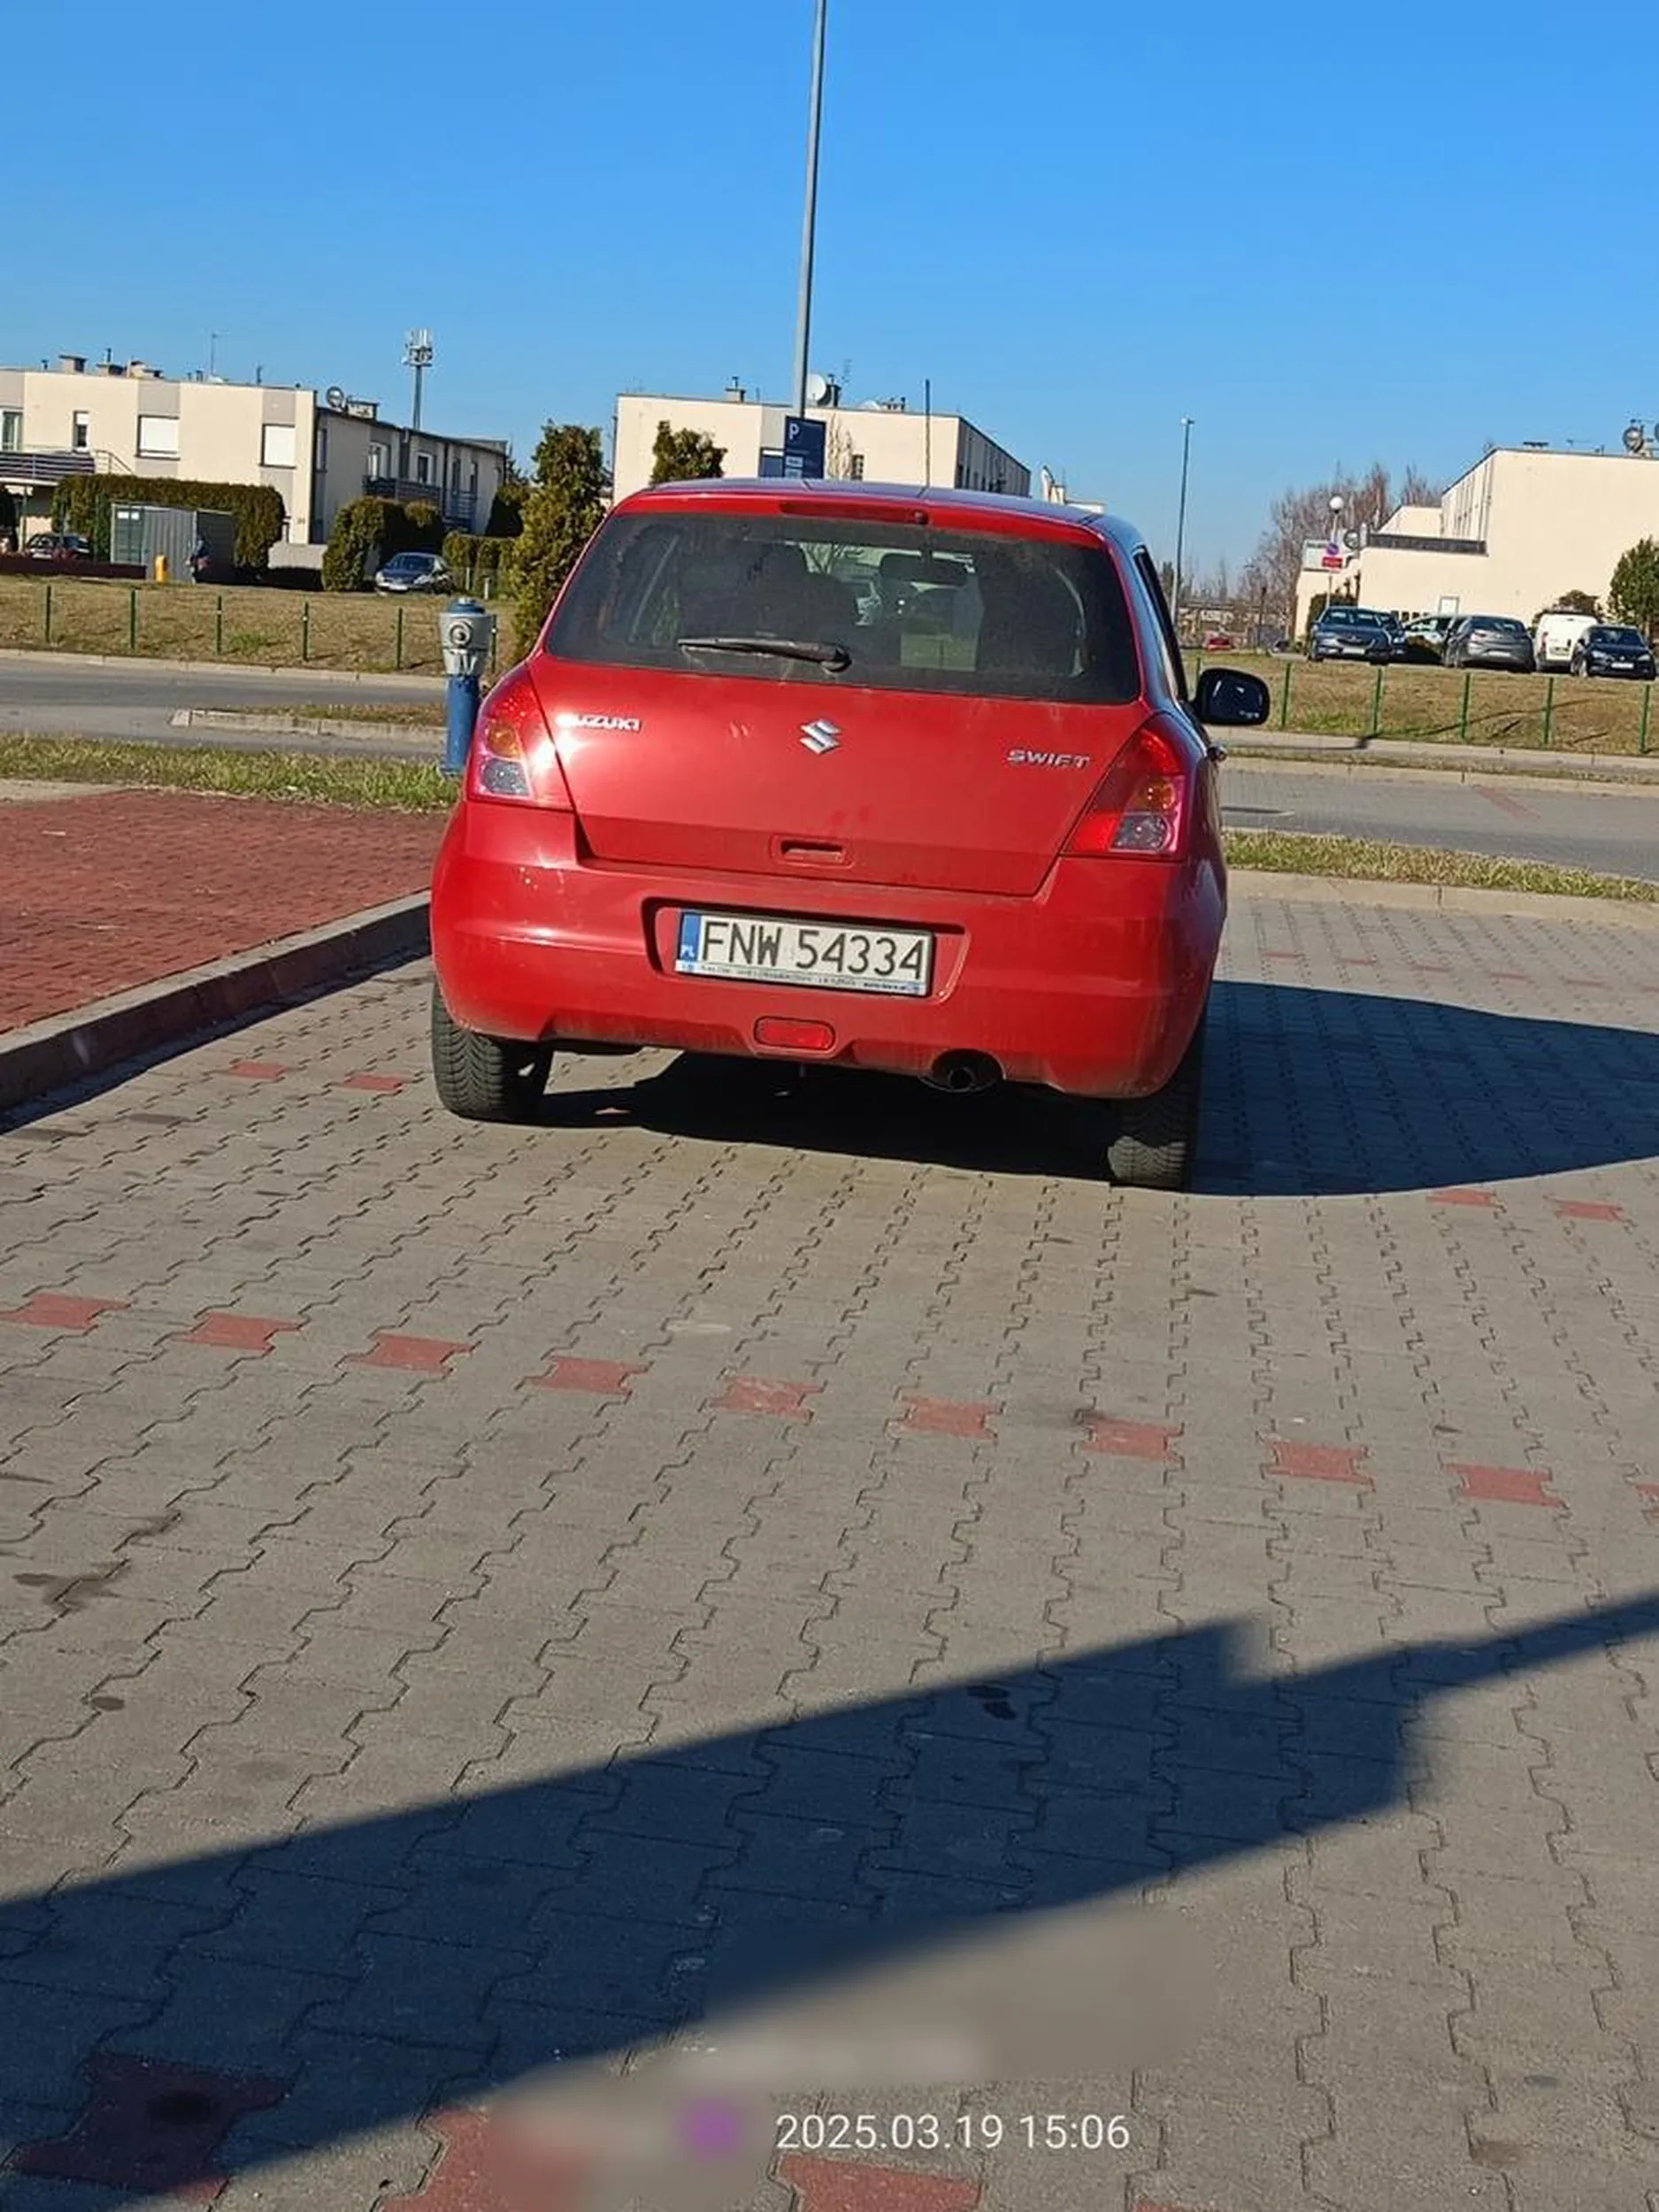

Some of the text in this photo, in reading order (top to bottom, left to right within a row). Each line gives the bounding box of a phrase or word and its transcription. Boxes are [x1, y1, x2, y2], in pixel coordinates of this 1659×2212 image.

[788, 423, 800, 440] P
[555, 712, 641, 731] UZUKI
[1007, 749, 1090, 769] SWIFT
[703, 920, 781, 967] FNW
[795, 929, 924, 980] 54334
